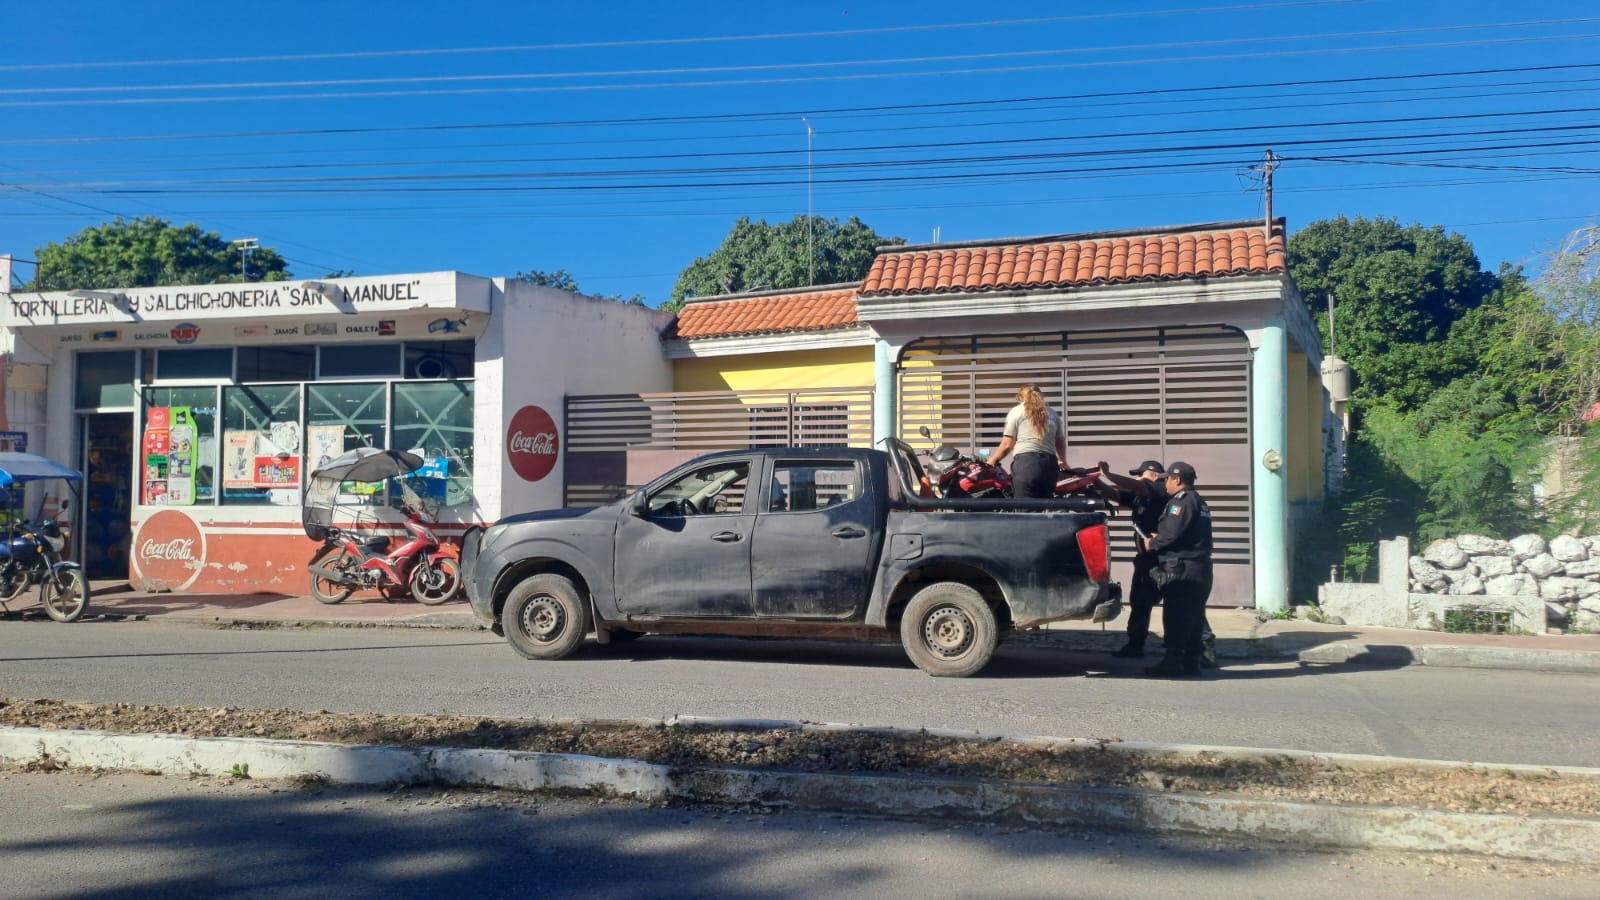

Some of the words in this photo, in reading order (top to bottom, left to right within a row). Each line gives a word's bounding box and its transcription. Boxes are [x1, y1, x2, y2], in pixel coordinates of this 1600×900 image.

[11, 297, 108, 317] TORTILLERIA
[510, 430, 556, 454] Coca-Cola
[141, 538, 195, 560] Coca-Cola
